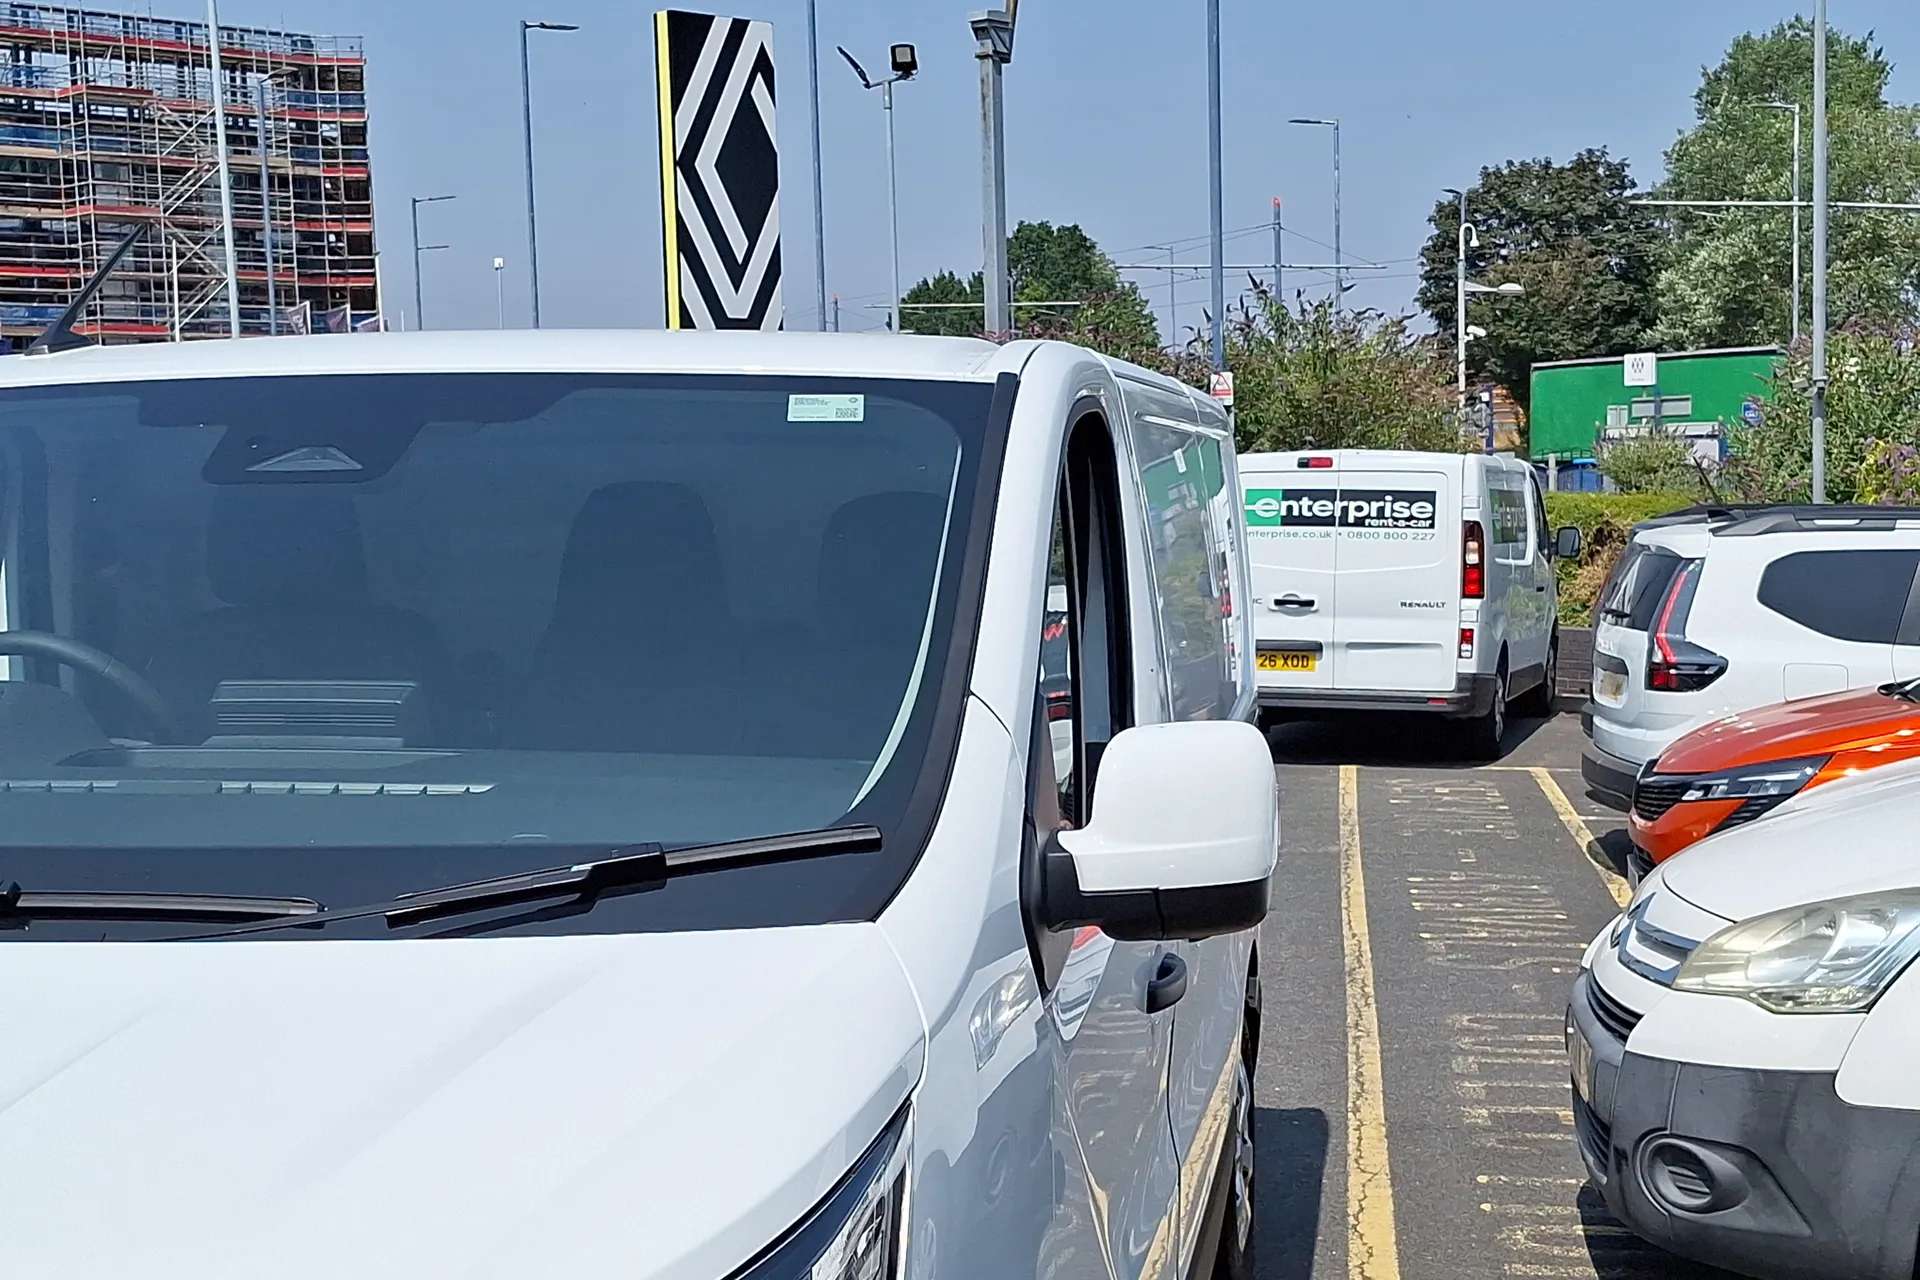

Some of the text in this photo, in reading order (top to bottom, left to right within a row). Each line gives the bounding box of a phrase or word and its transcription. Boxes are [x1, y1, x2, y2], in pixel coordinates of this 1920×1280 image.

[1244, 495, 1434, 524] enterprise
[1364, 518, 1433, 528] rent-a-car
[1347, 531, 1380, 540] 0800
[1383, 532, 1409, 541] 800
[1411, 532, 1436, 541] 227
[1400, 601, 1446, 609] RENAULT
[1257, 653, 1277, 668] 26
